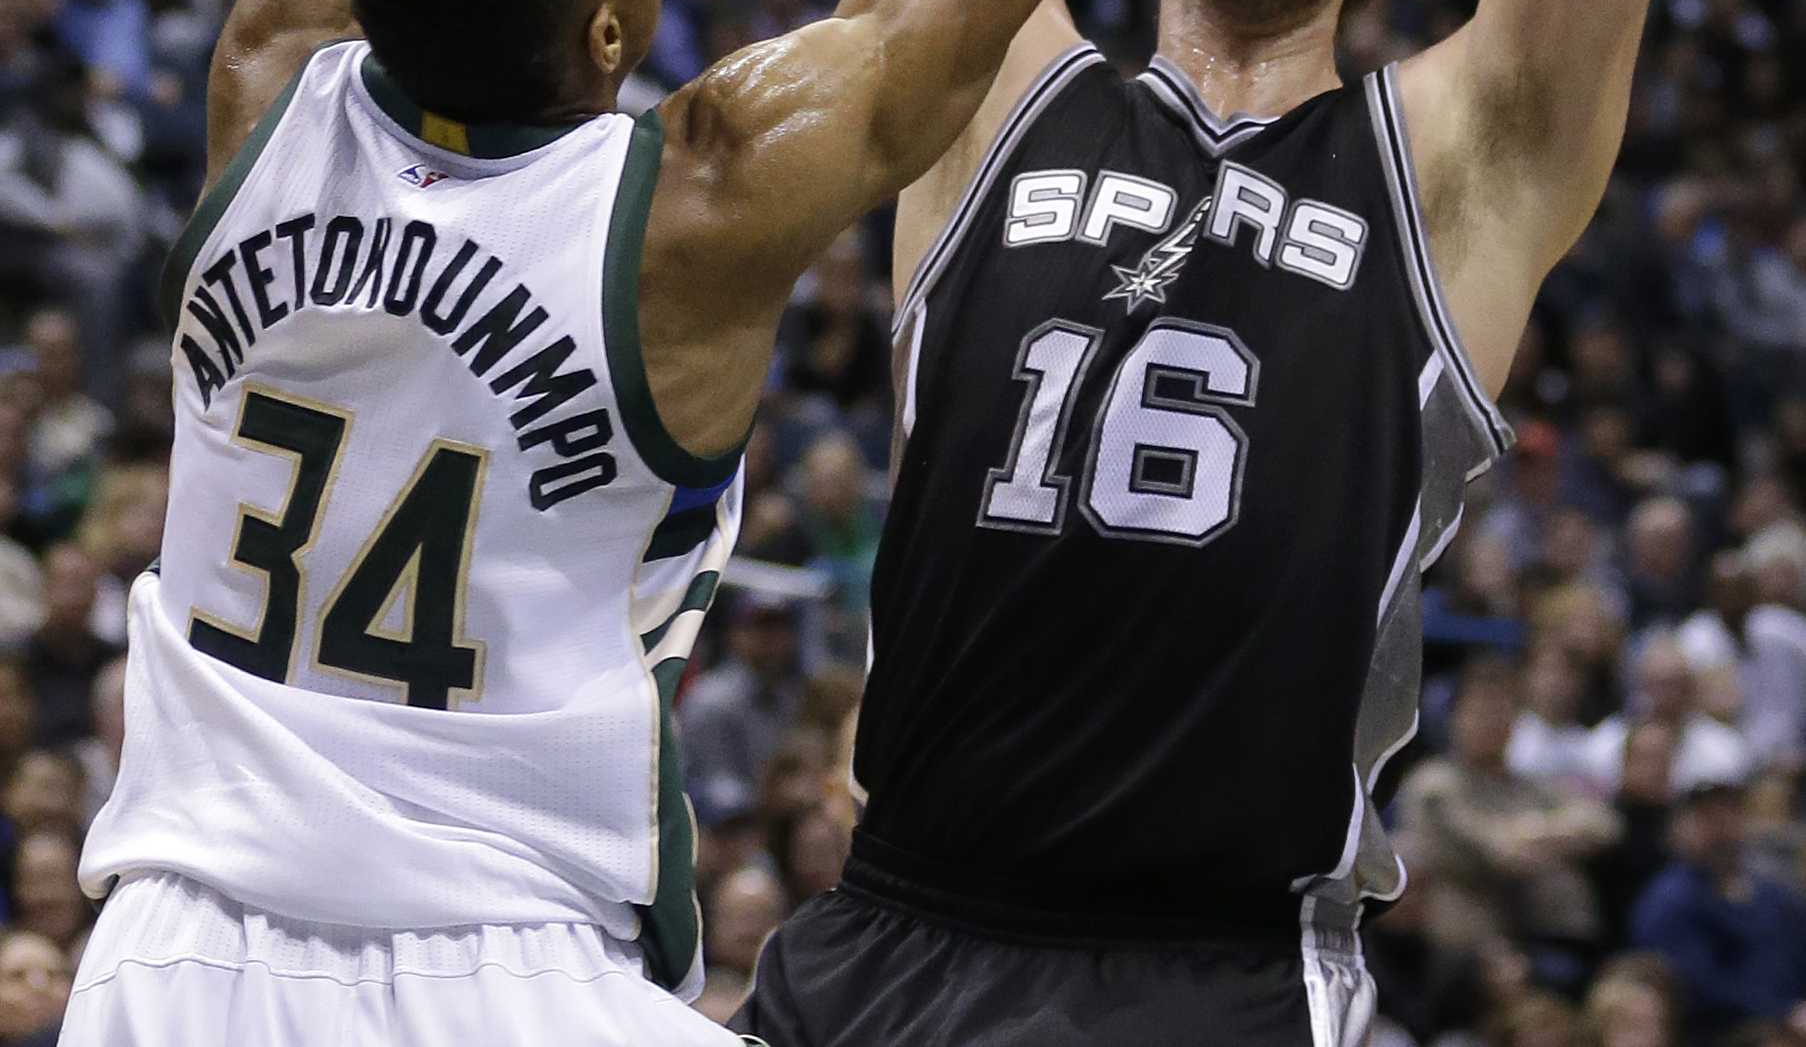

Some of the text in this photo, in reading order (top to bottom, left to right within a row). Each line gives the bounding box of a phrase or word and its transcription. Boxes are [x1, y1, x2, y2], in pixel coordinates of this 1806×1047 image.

[180, 213, 618, 513] ANTETOKOUNMPO
[975, 316, 1261, 548] 16
[186, 379, 491, 711] 34
